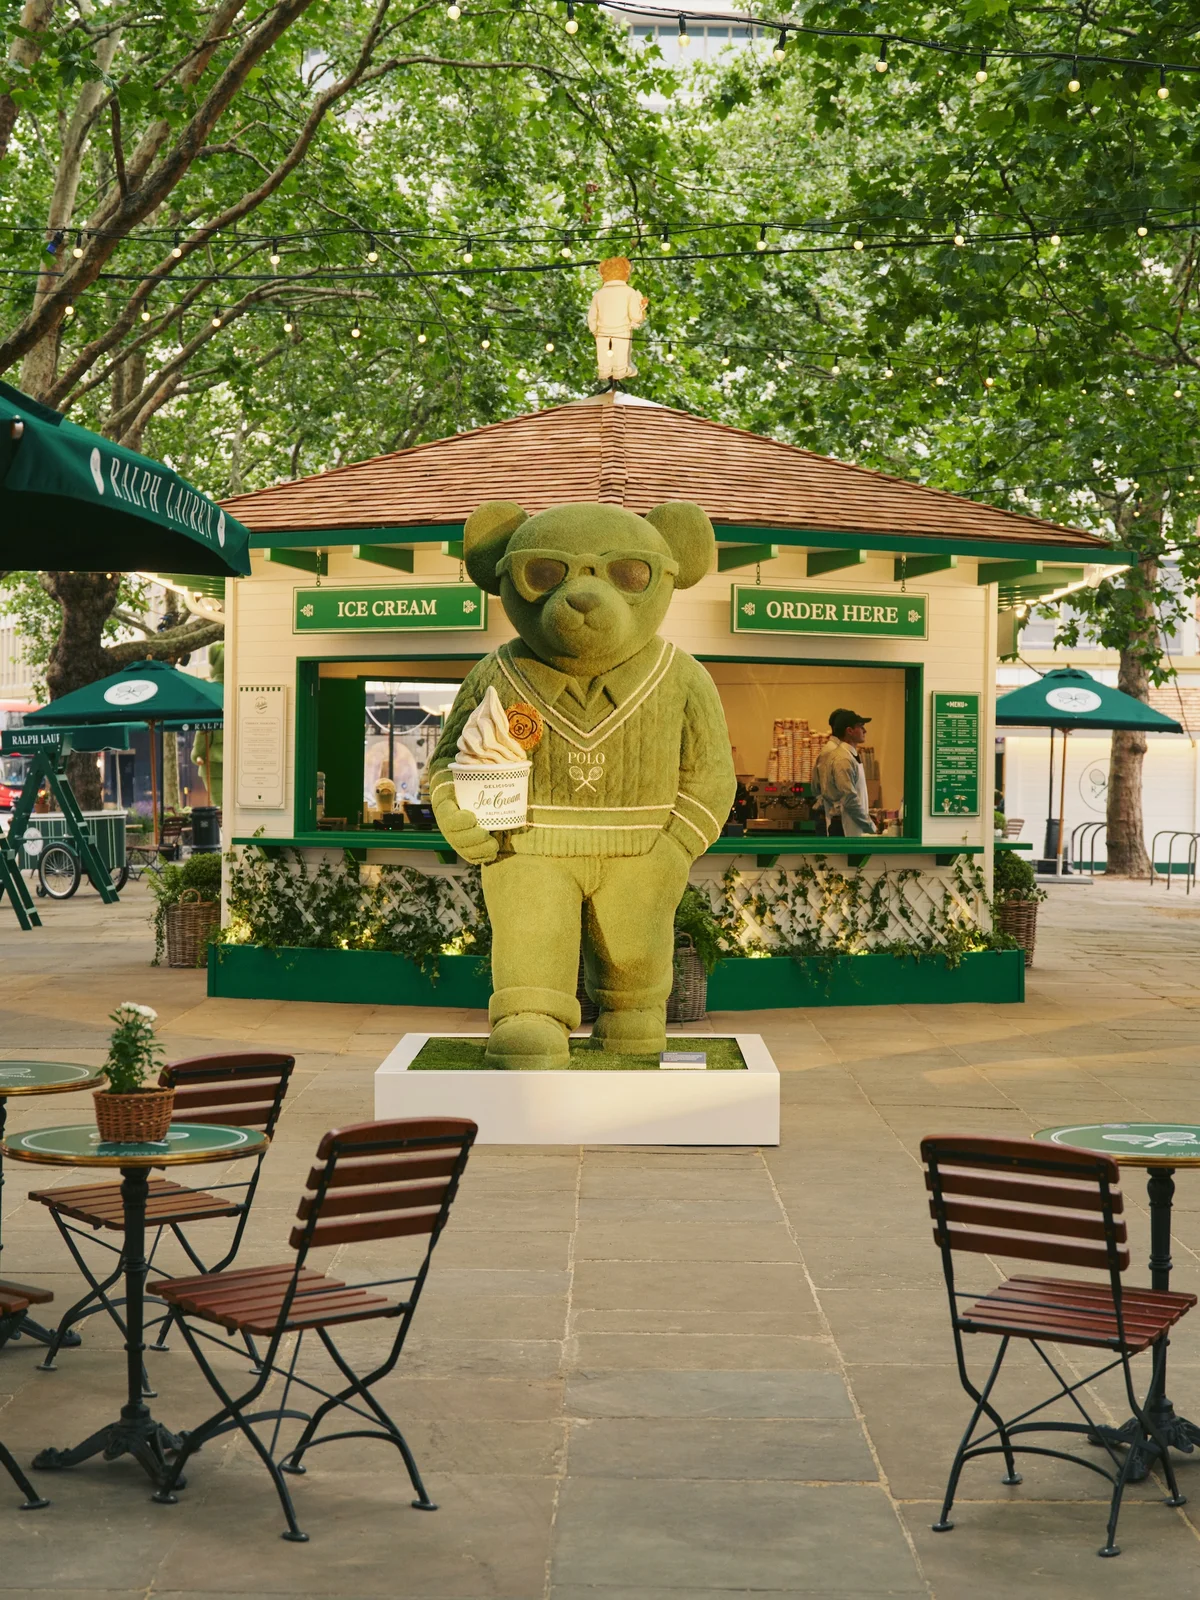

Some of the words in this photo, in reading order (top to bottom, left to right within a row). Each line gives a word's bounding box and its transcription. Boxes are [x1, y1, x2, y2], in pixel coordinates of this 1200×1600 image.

[110, 457, 162, 514] RALPH
[165, 482, 214, 540] LAUREN
[337, 601, 368, 617] ICE
[372, 599, 437, 616] CREAM
[766, 601, 838, 621] ORDER
[842, 604, 899, 623] HERE
[12, 735, 39, 745] RALPH
[568, 752, 605, 765] POLO
[473, 790, 492, 810] Ice
[493, 791, 521, 809] Cream
